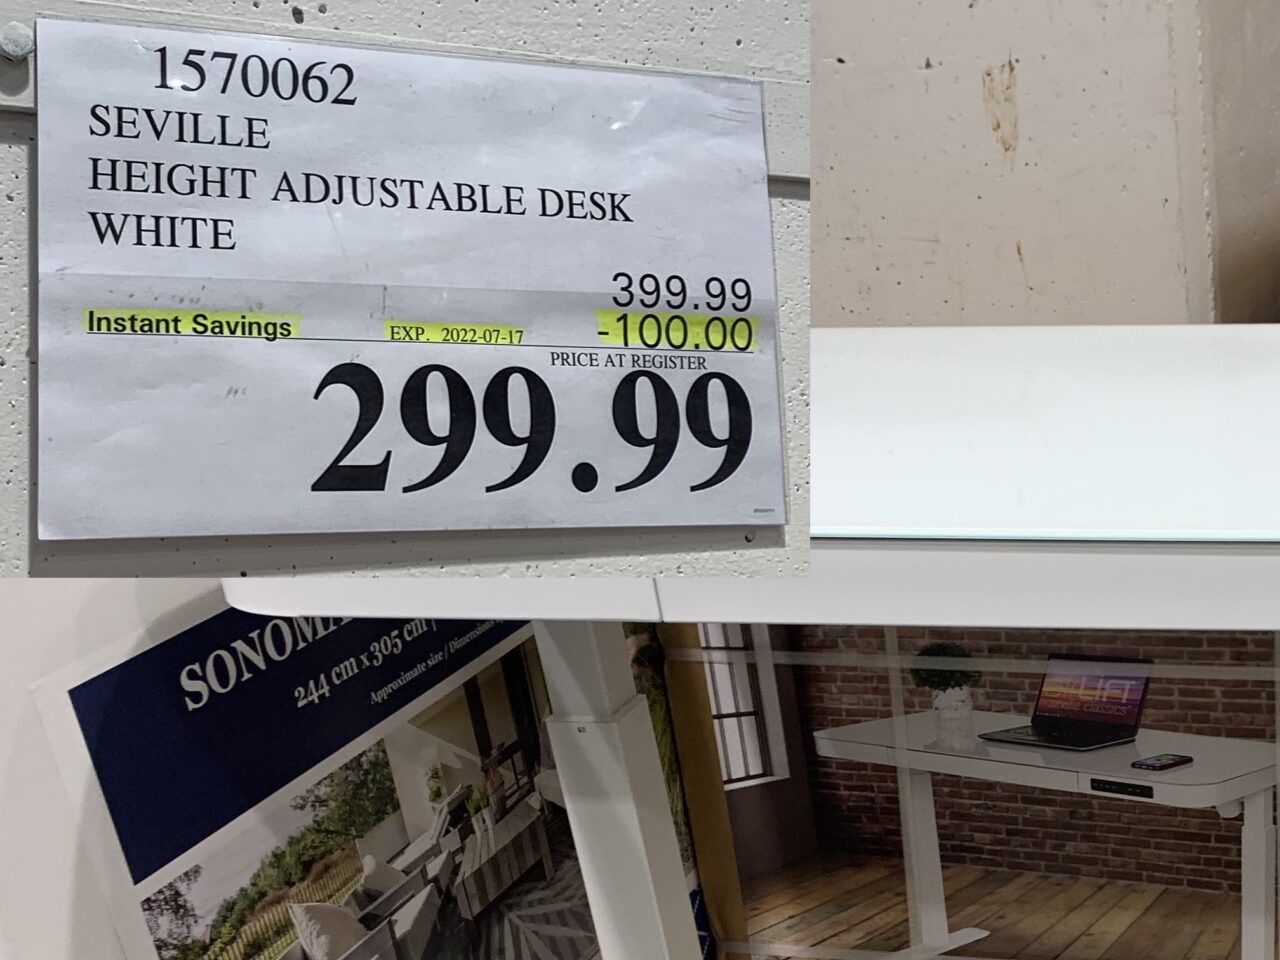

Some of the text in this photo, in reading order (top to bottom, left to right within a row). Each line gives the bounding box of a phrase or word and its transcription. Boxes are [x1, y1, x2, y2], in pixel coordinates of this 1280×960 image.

[153, 46, 358, 106] 1570062
[89, 104, 271, 149] SEVILLE
[88, 157, 634, 222] HEIGHT ADJUSTABLE DESK
[92, 212, 237, 251] WHITE
[612, 272, 752, 312] 399.99
[88, 311, 292, 341] Instant Savings
[389, 325, 524, 345] EXP. 2022-07-17
[597, 313, 752, 351] -100.00
[551, 351, 708, 371] PRICE AT REGISTER
[310, 362, 753, 493] 299.99
[294, 674, 331, 708] 244
[331, 656, 360, 685] cm
[358, 652, 371, 668] x
[370, 629, 404, 666] 305
[370, 620, 495, 704] Approximate size Dimensions
